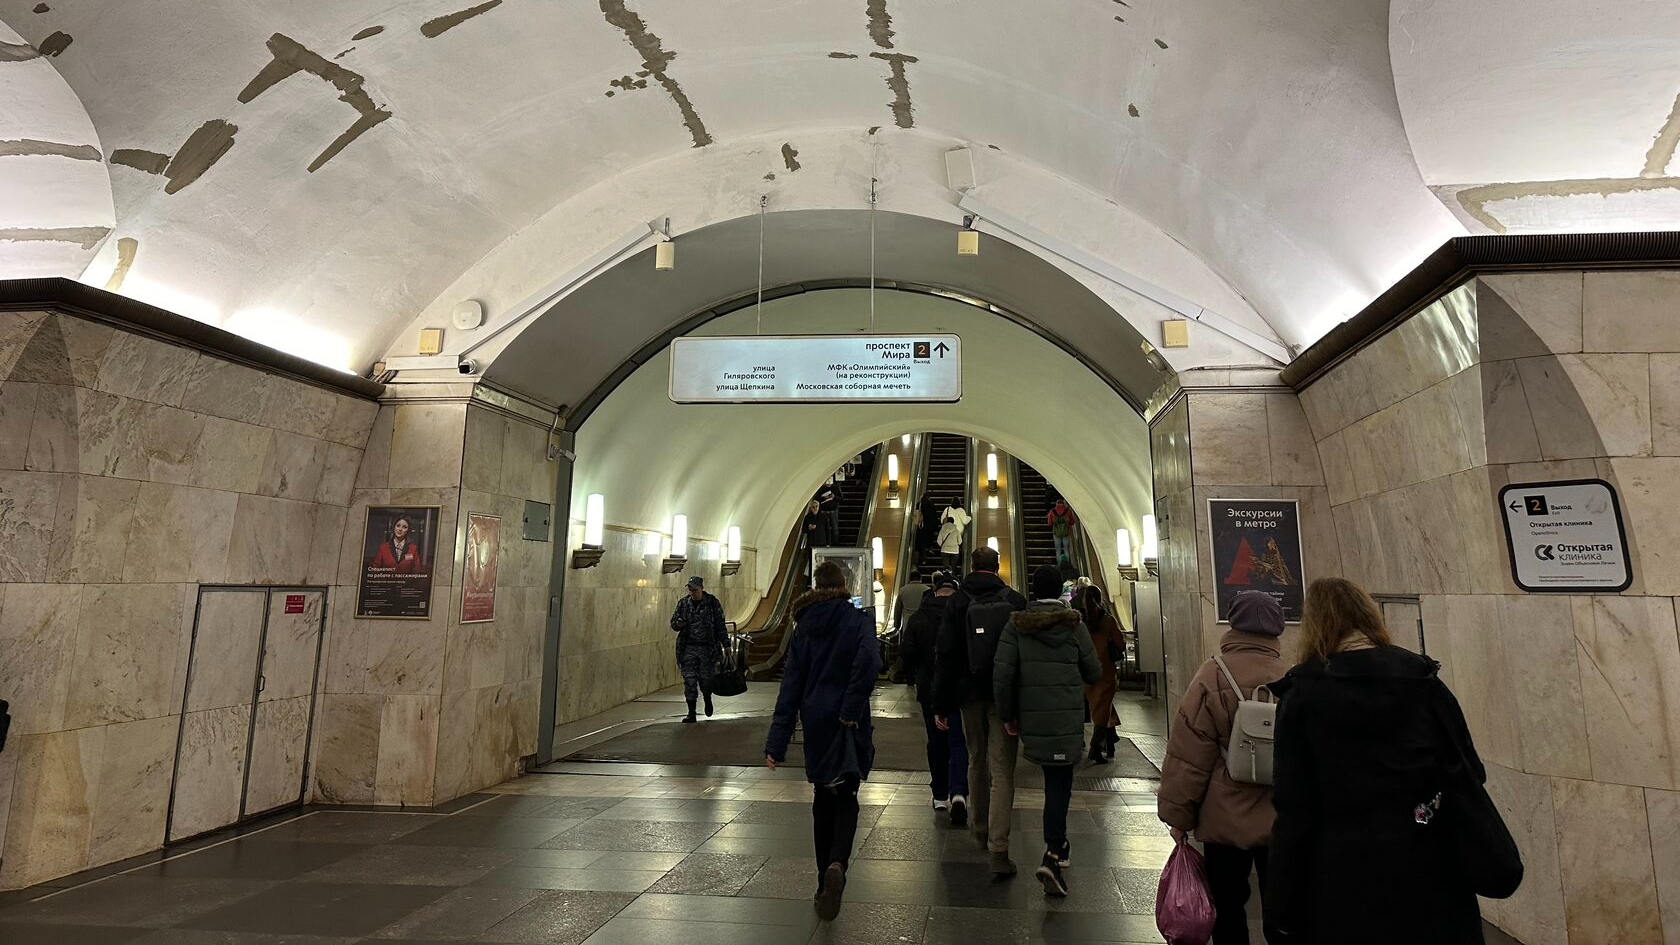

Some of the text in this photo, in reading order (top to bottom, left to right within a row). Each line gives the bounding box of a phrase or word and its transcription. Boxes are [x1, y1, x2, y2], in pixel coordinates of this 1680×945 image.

[866, 342, 911, 351] проспект
[918, 345, 926, 355] 2
[882, 351, 911, 360] Мира
[849, 363, 911, 371] «Олимпийский»
[1531, 500, 1541, 511] 2
[1227, 508, 1283, 519] Экскурсии
[1244, 520, 1276, 529] метро
[1557, 544, 1613, 553] Открытая
[1559, 552, 1602, 560] клиника
